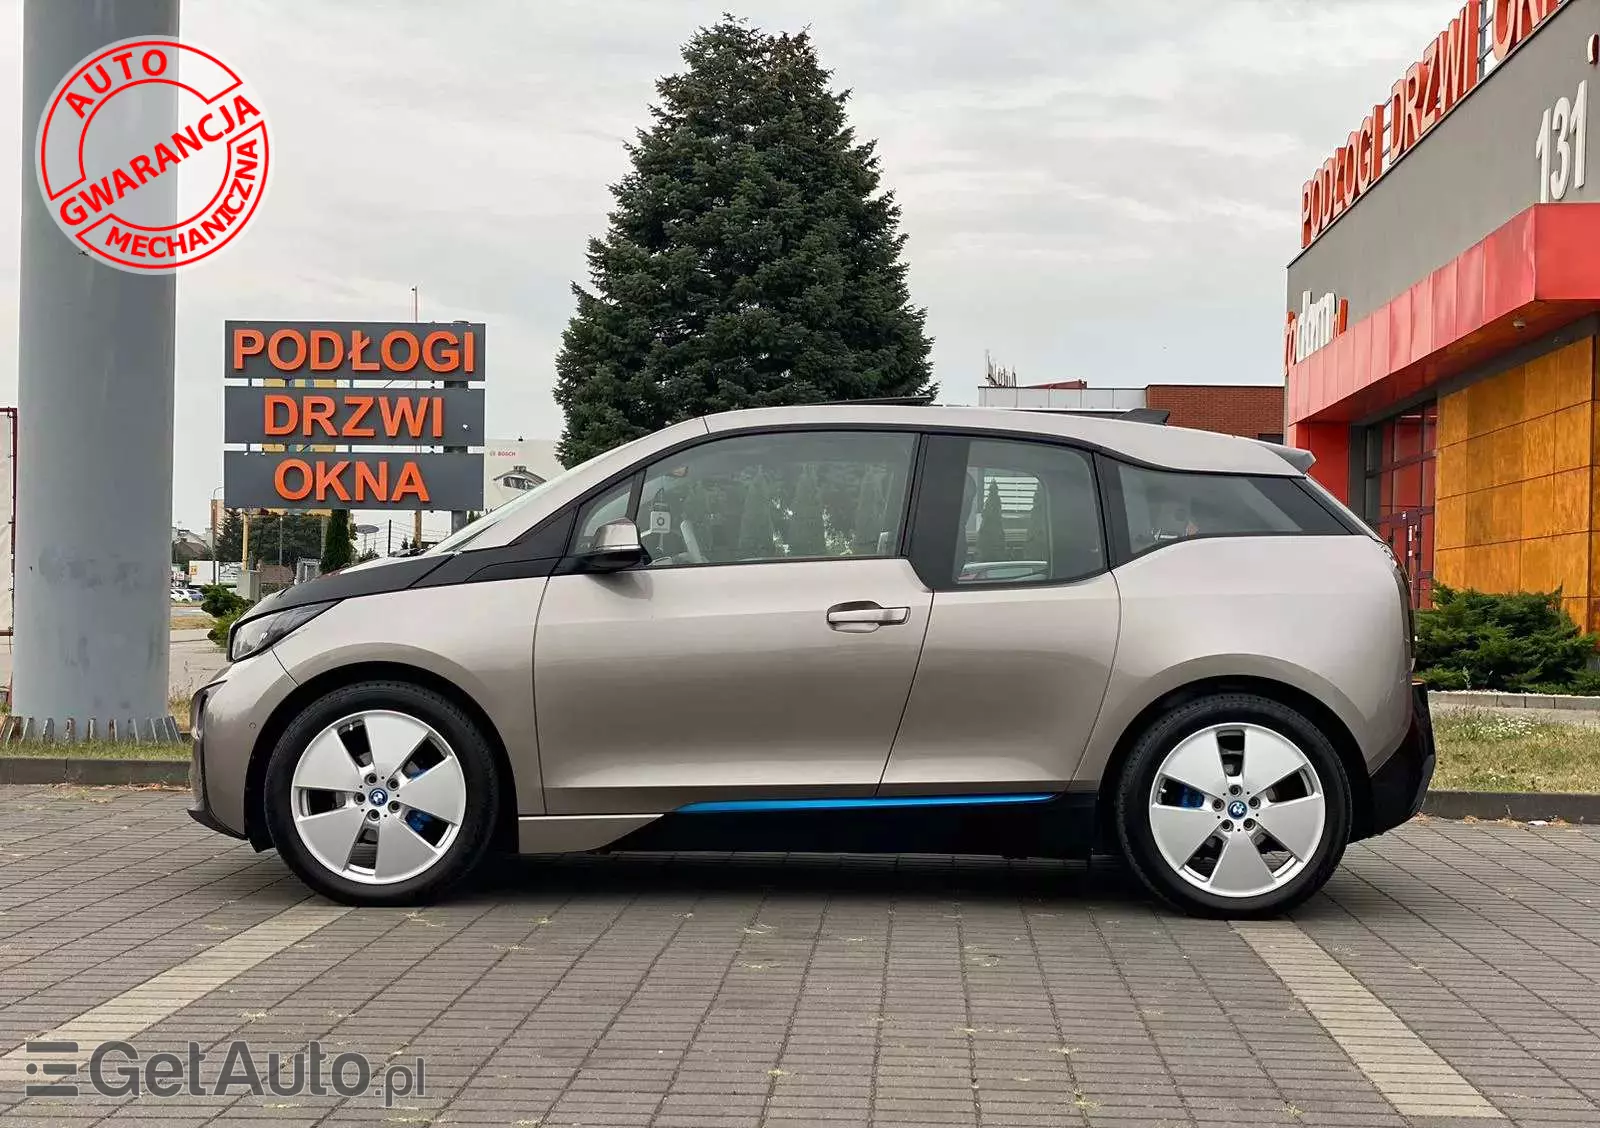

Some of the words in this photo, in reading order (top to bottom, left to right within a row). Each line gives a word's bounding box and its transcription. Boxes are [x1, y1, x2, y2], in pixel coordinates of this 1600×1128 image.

[1301, 104, 1385, 249] PODŁOGI
[1389, 0, 1478, 165] DRZWI
[1536, 80, 1587, 203] 131
[233, 329, 474, 373] PODŁOGI
[264, 394, 443, 437] DRZWI
[274, 458, 430, 502] OKNA
